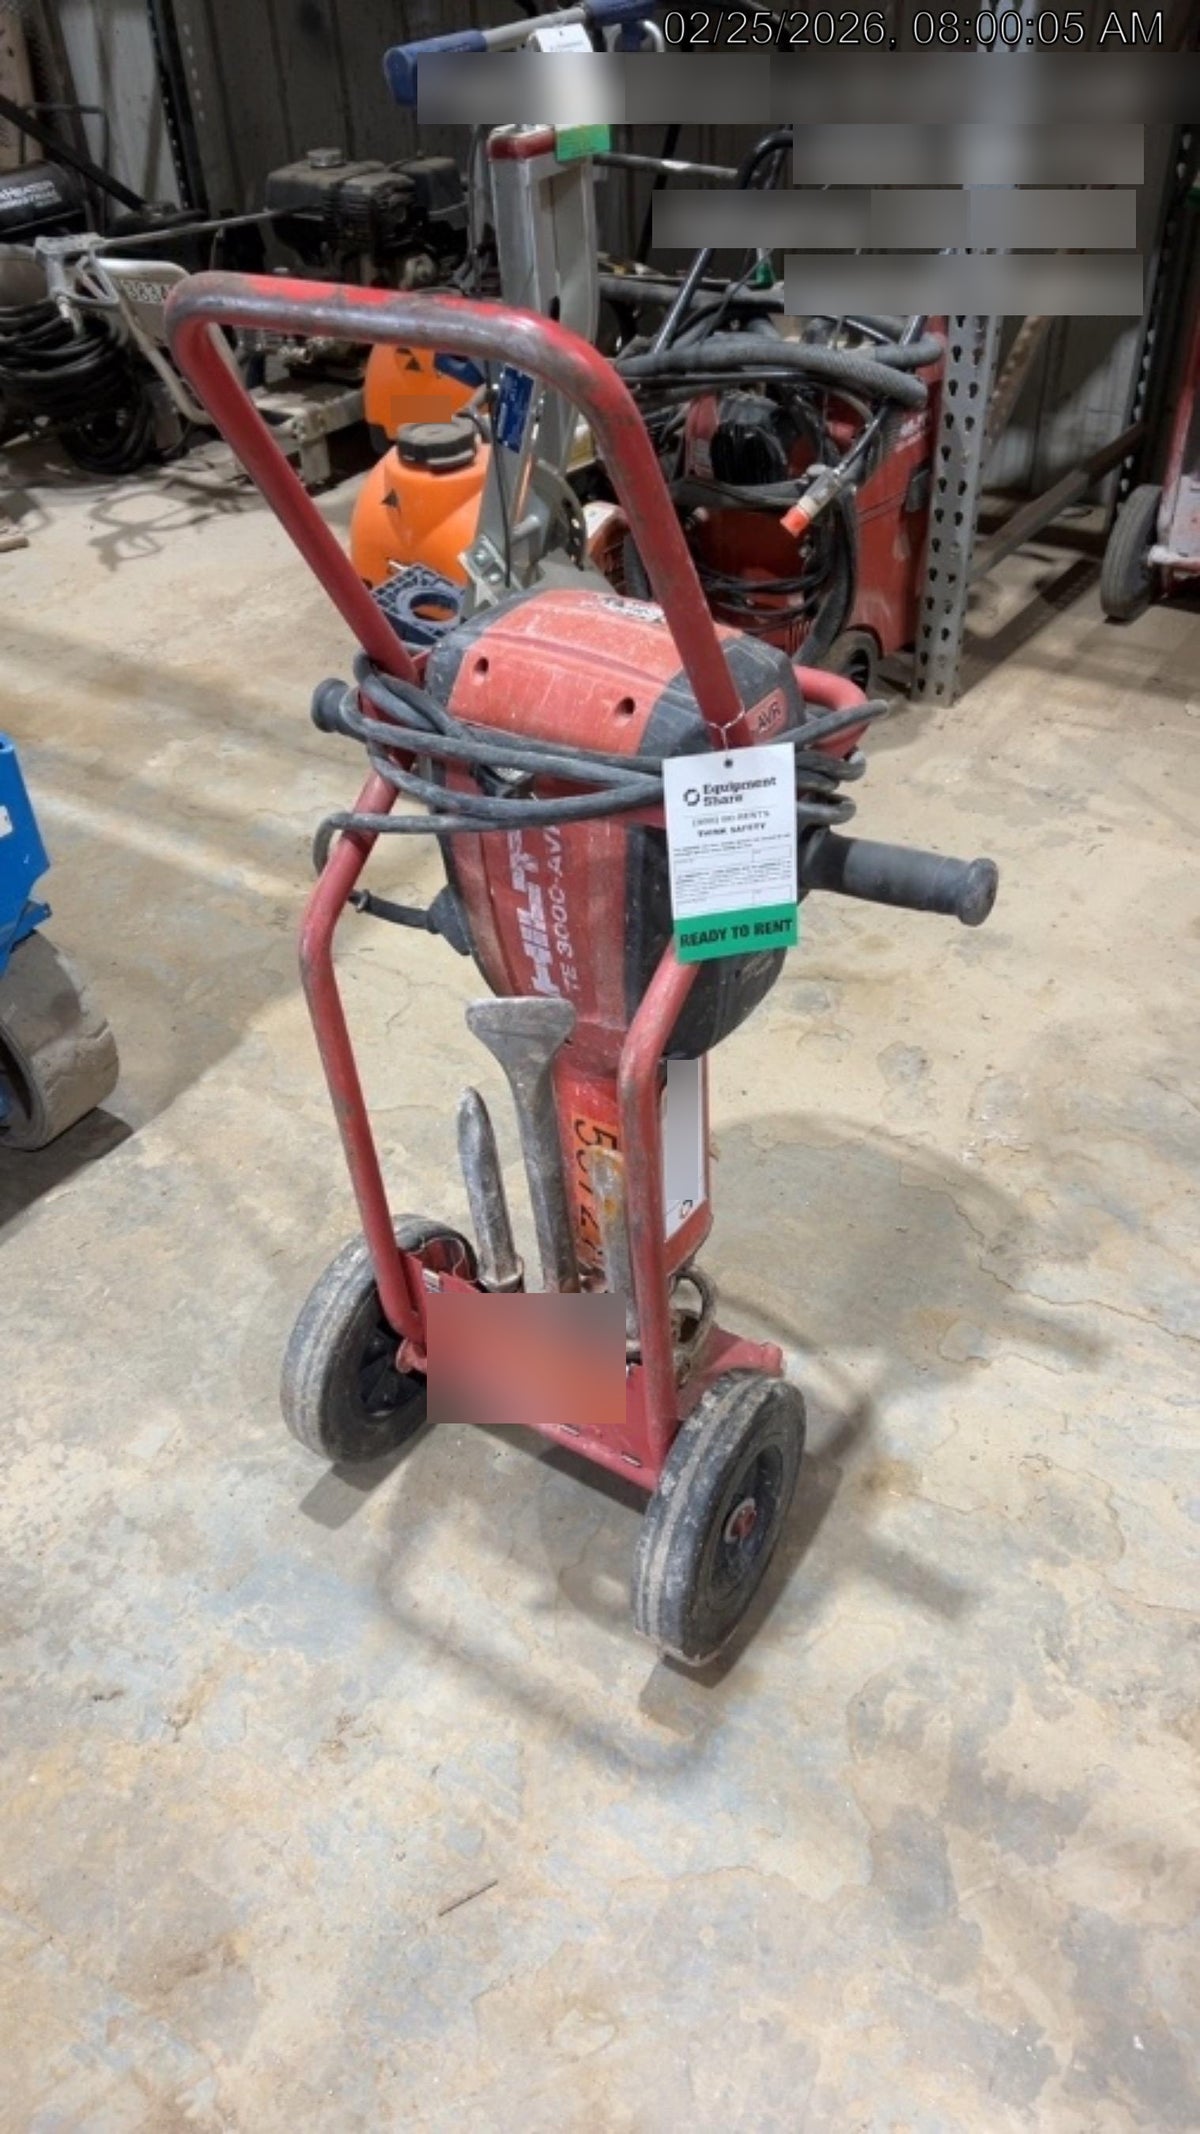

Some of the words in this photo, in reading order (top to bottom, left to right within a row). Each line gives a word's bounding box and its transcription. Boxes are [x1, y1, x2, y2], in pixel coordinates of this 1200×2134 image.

[756, 701, 782, 733] AVR
[703, 777, 777, 795] Equipment
[703, 793, 743, 807] Share
[680, 927, 728, 948] READY
[730, 923, 750, 939] TO
[753, 918, 793, 936] RENT
[559, 961, 580, 993] TE
